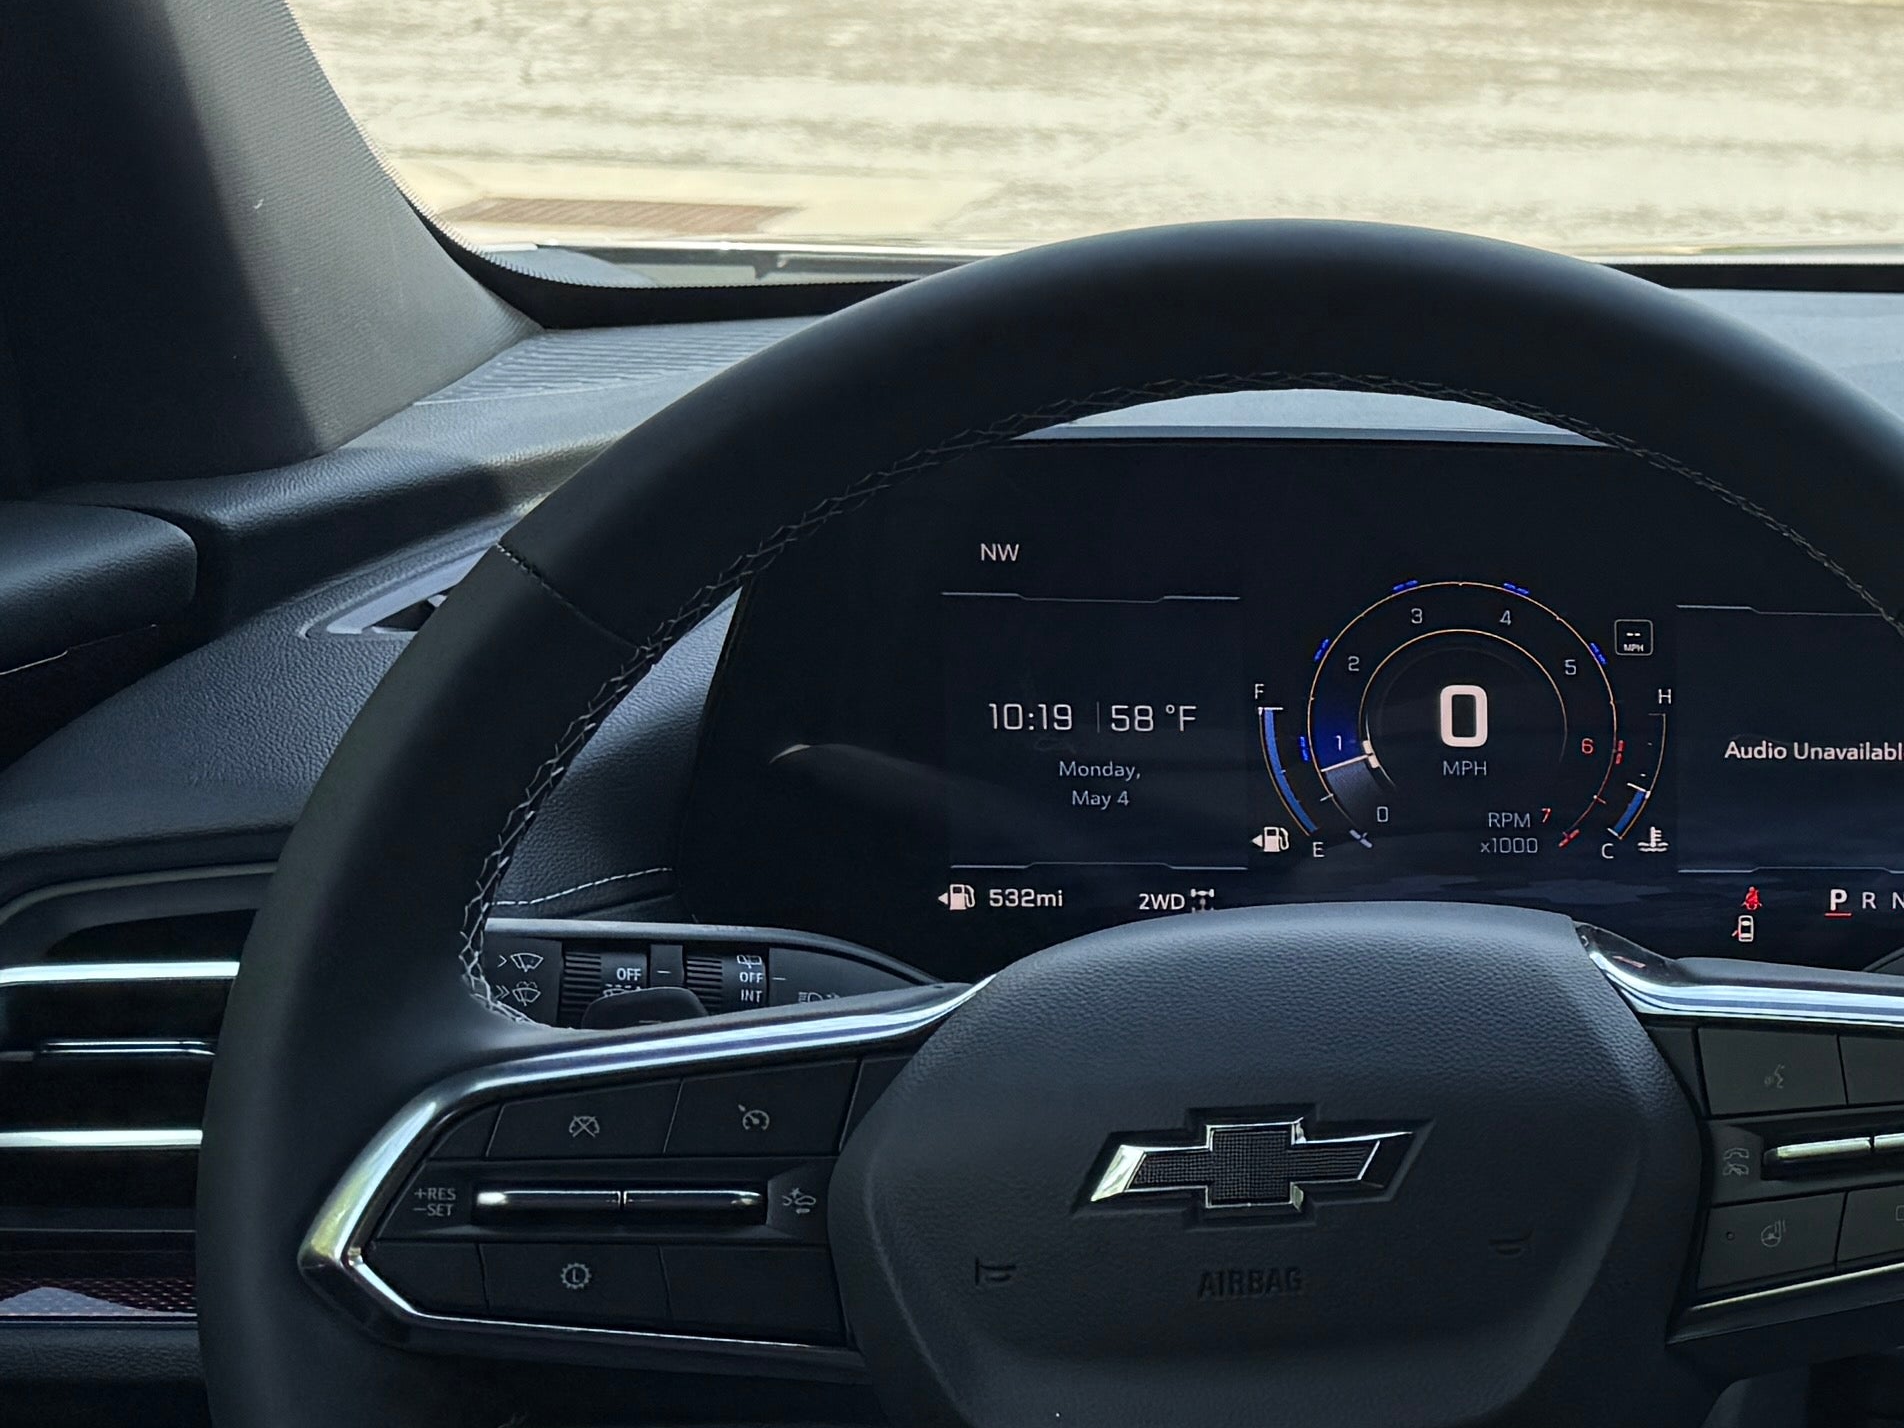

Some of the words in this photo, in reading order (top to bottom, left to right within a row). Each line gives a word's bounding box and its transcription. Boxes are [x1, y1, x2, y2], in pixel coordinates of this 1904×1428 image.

[980, 543, 1020, 562] NW
[1410, 607, 1423, 624] 3
[1499, 609, 1512, 626] 4
[1623, 643, 1645, 653] MPH
[1347, 655, 1360, 672] 2
[1564, 659, 1577, 676] 5
[1254, 683, 1265, 700] F
[1658, 688, 1672, 705] H
[988, 703, 1073, 731] 10:19
[1111, 704, 1154, 732] 58
[1439, 684, 1488, 748] 0
[1335, 733, 1344, 751] 1
[1581, 737, 1594, 755] 6
[1724, 740, 1787, 760] Audio
[1059, 760, 1141, 782] Monday,
[1442, 760, 1487, 776] MPH
[1071, 789, 1112, 811] May
[1116, 790, 1130, 806] 4
[1376, 805, 1389, 823] 0
[1488, 811, 1531, 828] RPM
[1541, 807, 1552, 823] 7
[1312, 841, 1325, 858] E
[1480, 837, 1538, 854] x1000
[1601, 842, 1614, 859] C
[989, 888, 1063, 908] 532mi
[1138, 893, 1186, 910] 2WD
[1829, 887, 1849, 912] P
[1862, 891, 1877, 910] R
[616, 966, 643, 983] OFF
[739, 970, 764, 986] OFF
[740, 988, 764, 1004] INT
[1198, 1266, 1303, 1300] AIRBAG
